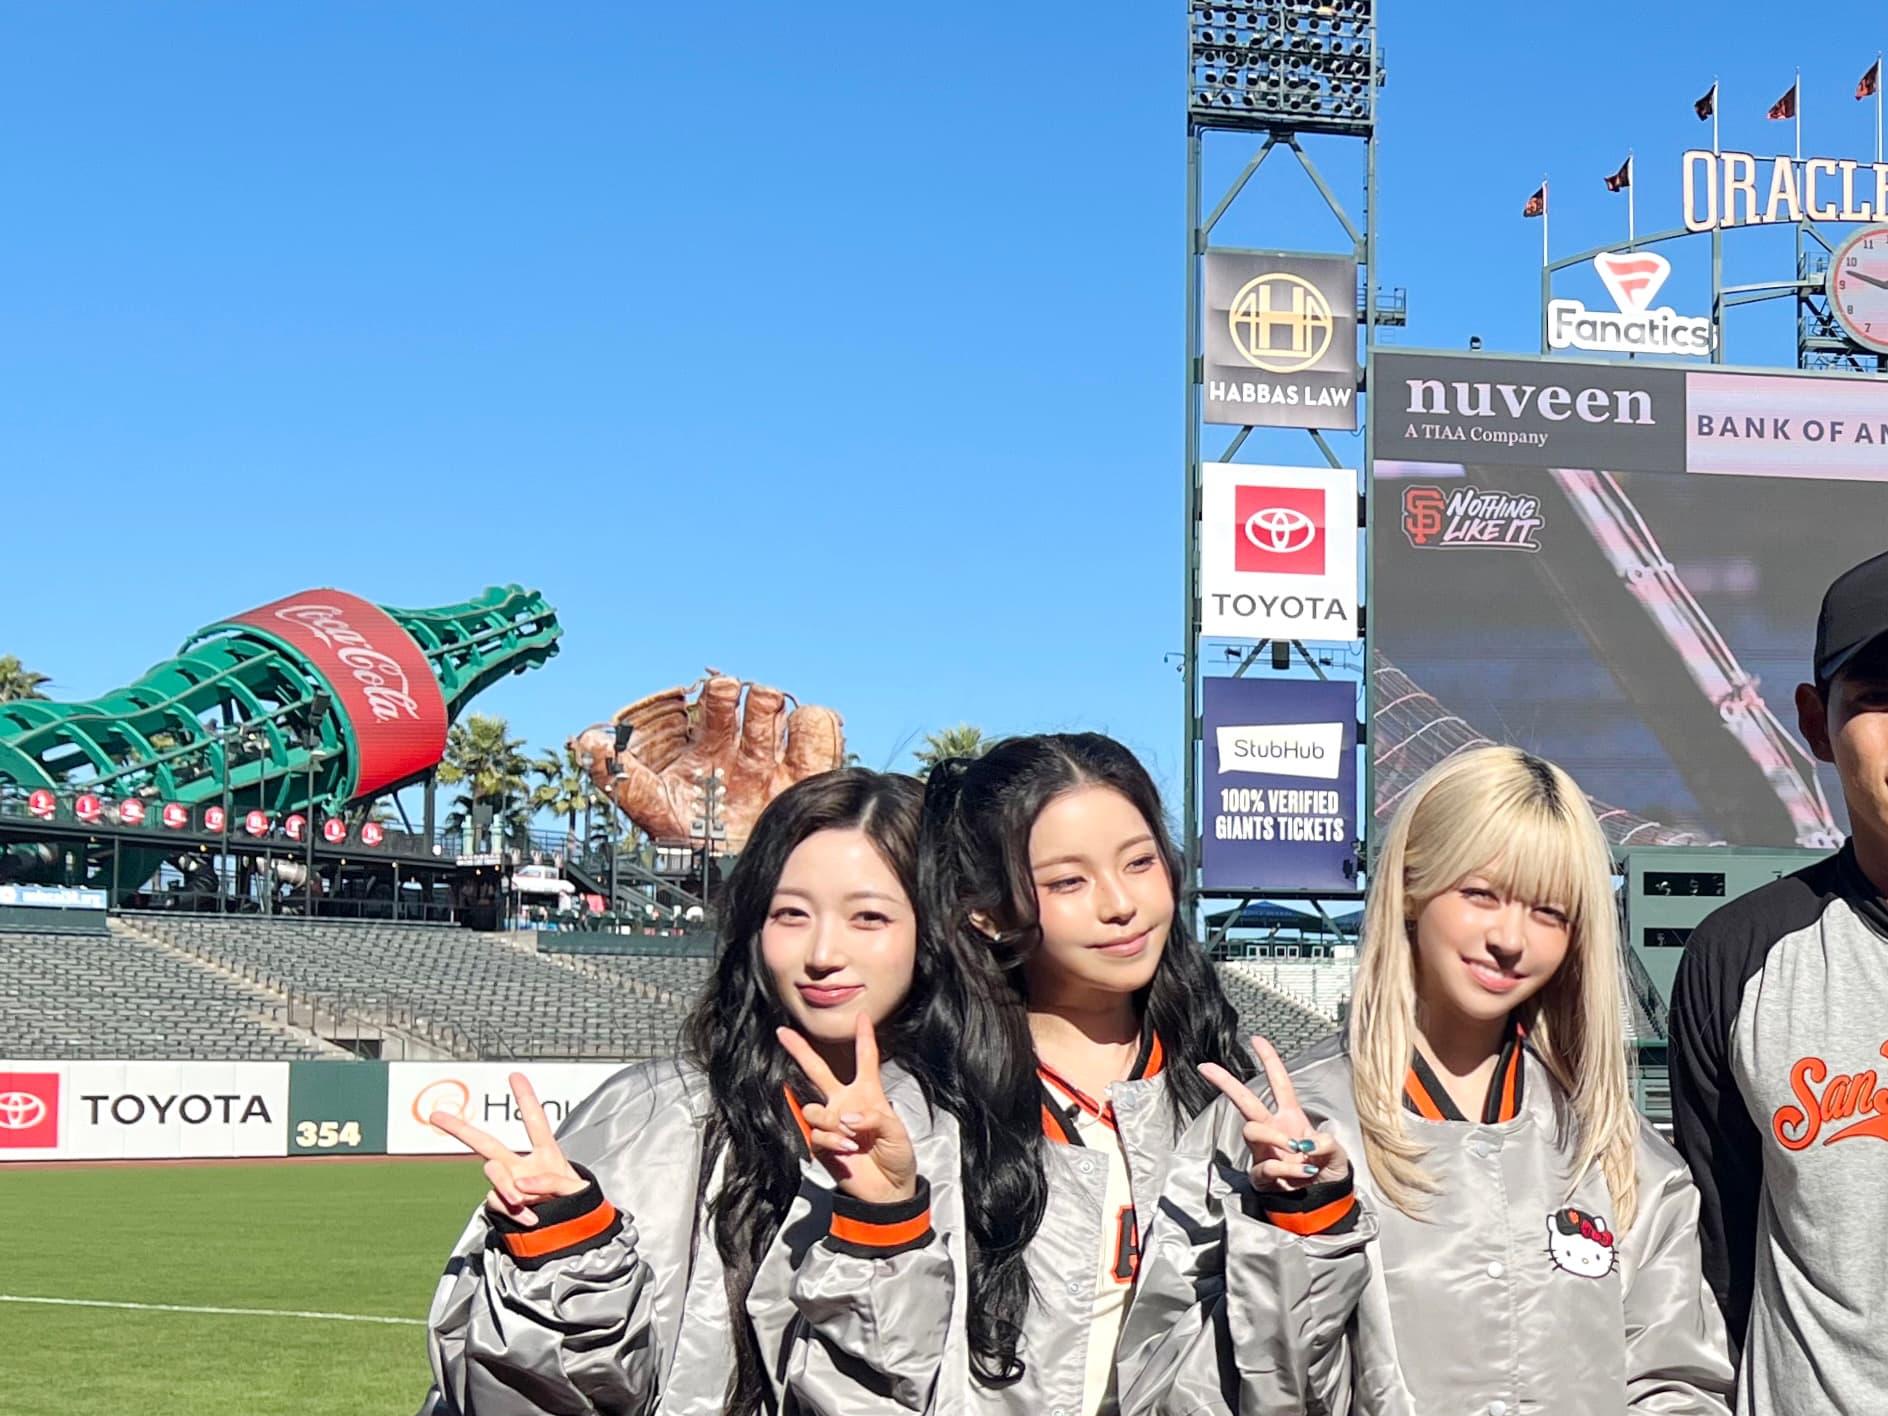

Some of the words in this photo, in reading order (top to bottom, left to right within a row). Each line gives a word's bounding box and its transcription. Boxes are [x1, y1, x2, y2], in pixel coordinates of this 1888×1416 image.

[1863, 239, 1874, 249] 11
[1846, 256, 1858, 267] 10
[1839, 280, 1846, 289] 9
[1846, 305, 1854, 315] 8
[1556, 307, 1710, 348] Fanatics
[1864, 323, 1872, 333] 7
[1209, 380, 1300, 406] HABBAS
[1304, 386, 1352, 408] LAW
[1405, 378, 1656, 425] nuveen
[1404, 423, 1418, 439] A
[1421, 424, 1466, 441] TIAA
[1470, 426, 1549, 448] Company
[1697, 414, 1791, 441] BANK
[1802, 419, 1844, 443] OF
[1406, 488, 1446, 544] SF
[1446, 489, 1536, 519] NOTHING
[1443, 515, 1505, 542] LIKE
[1504, 518, 1541, 544] IT
[1211, 592, 1348, 621] TOYOTA
[275, 604, 419, 723] Coca-Cola
[1234, 739, 1325, 759] StubHub
[1221, 788, 1265, 813] 100%
[1268, 789, 1339, 815] VERIFIED
[1215, 815, 1274, 841] GIANTS
[1277, 817, 1344, 842] TICKETS
[81, 1094, 272, 1125] TOYOTA
[1772, 1056, 1877, 1151] San
[295, 1120, 361, 1147] 354
